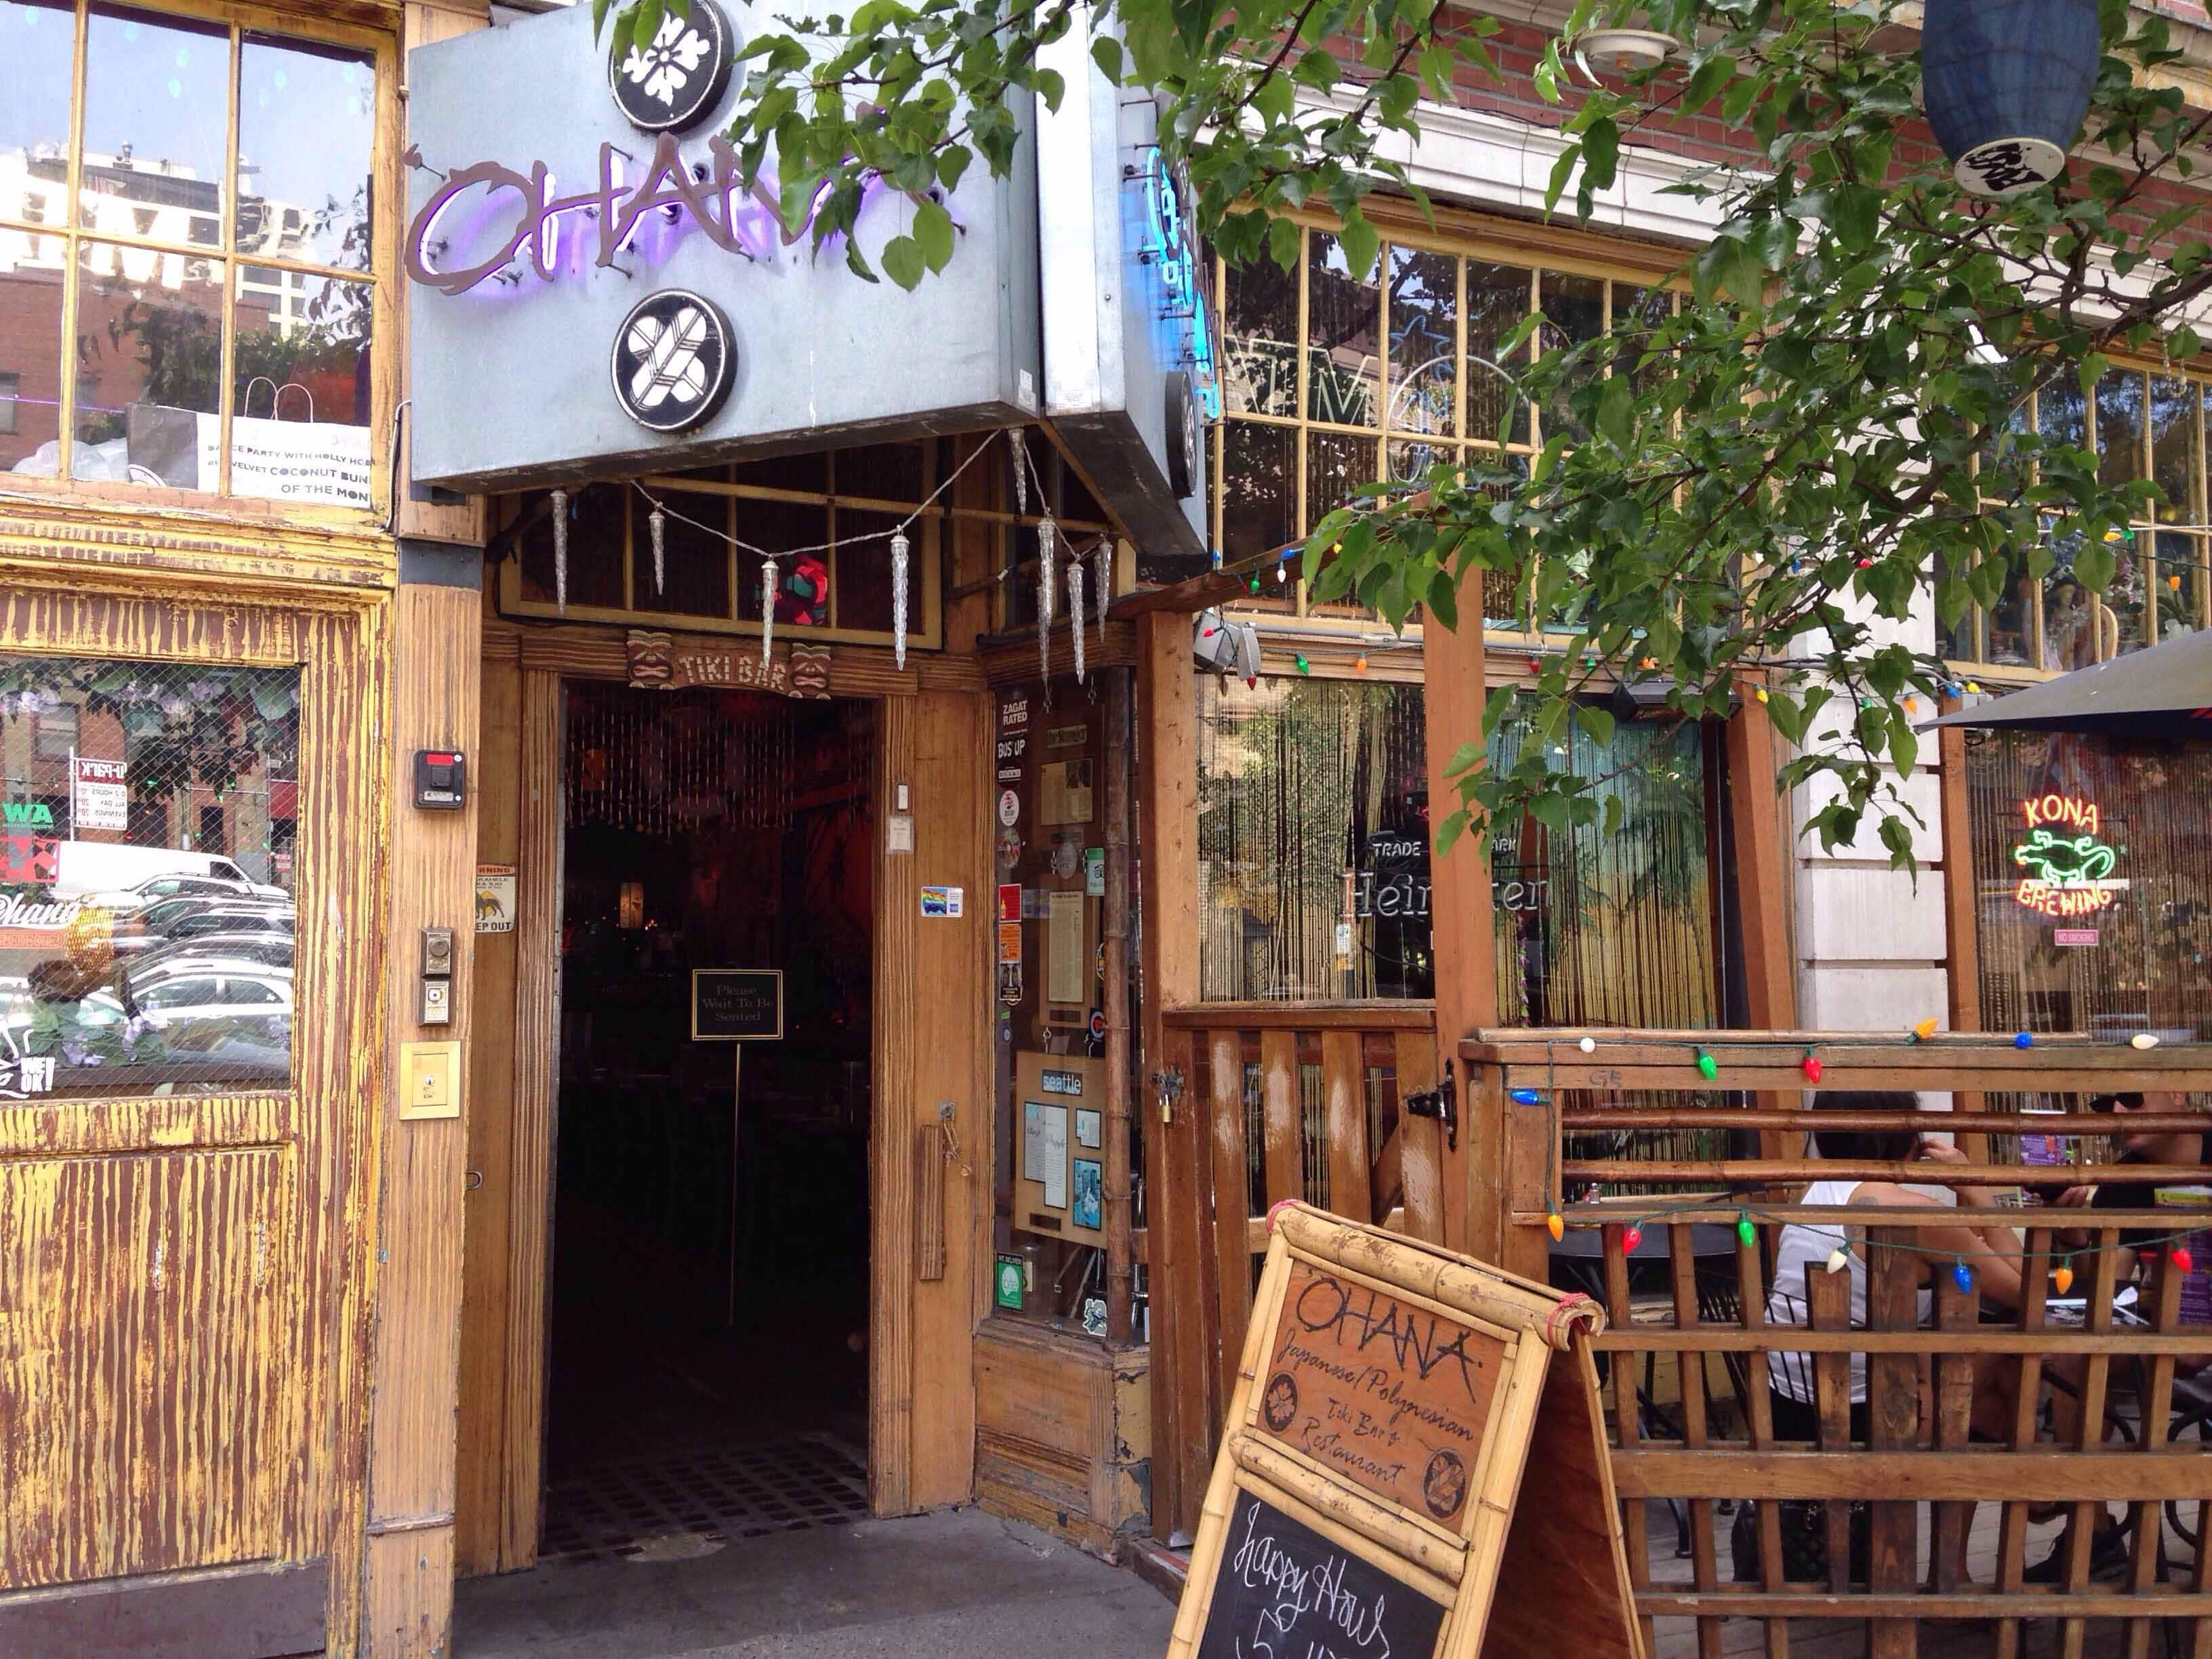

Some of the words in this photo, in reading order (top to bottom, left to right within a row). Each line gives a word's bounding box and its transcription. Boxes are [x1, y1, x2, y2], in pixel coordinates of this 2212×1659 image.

[407, 122, 932, 296] OHAN
[207, 445, 244, 453] DACE
[247, 447, 280, 458] PARTY
[314, 453, 346, 464] HOLLY
[270, 467, 337, 478] COCONUT
[341, 472, 370, 485] BUN
[281, 485, 300, 493] OF
[305, 485, 332, 495] THE
[337, 487, 371, 501] MON
[678, 655, 730, 683] TIKI
[739, 655, 786, 691] BAR
[1003, 700, 1027, 714] ZAGAT
[1003, 712, 1027, 726] RATED
[2024, 794, 2097, 835] KONA
[1372, 842, 1421, 857] TRADE
[1492, 838, 1517, 852] ARK
[2016, 879, 2113, 916] BREWING
[476, 922, 488, 931] EP
[491, 922, 511, 931] OUT
[2059, 933, 2068, 941] NO
[1043, 1073, 1082, 1096] seattle
[1296, 1277, 1477, 1404] OHANA
[1328, 1397, 1354, 1423] Tiki
[1353, 1411, 1385, 1439] Bar
[1300, 1416, 1406, 1485] Restaurant
